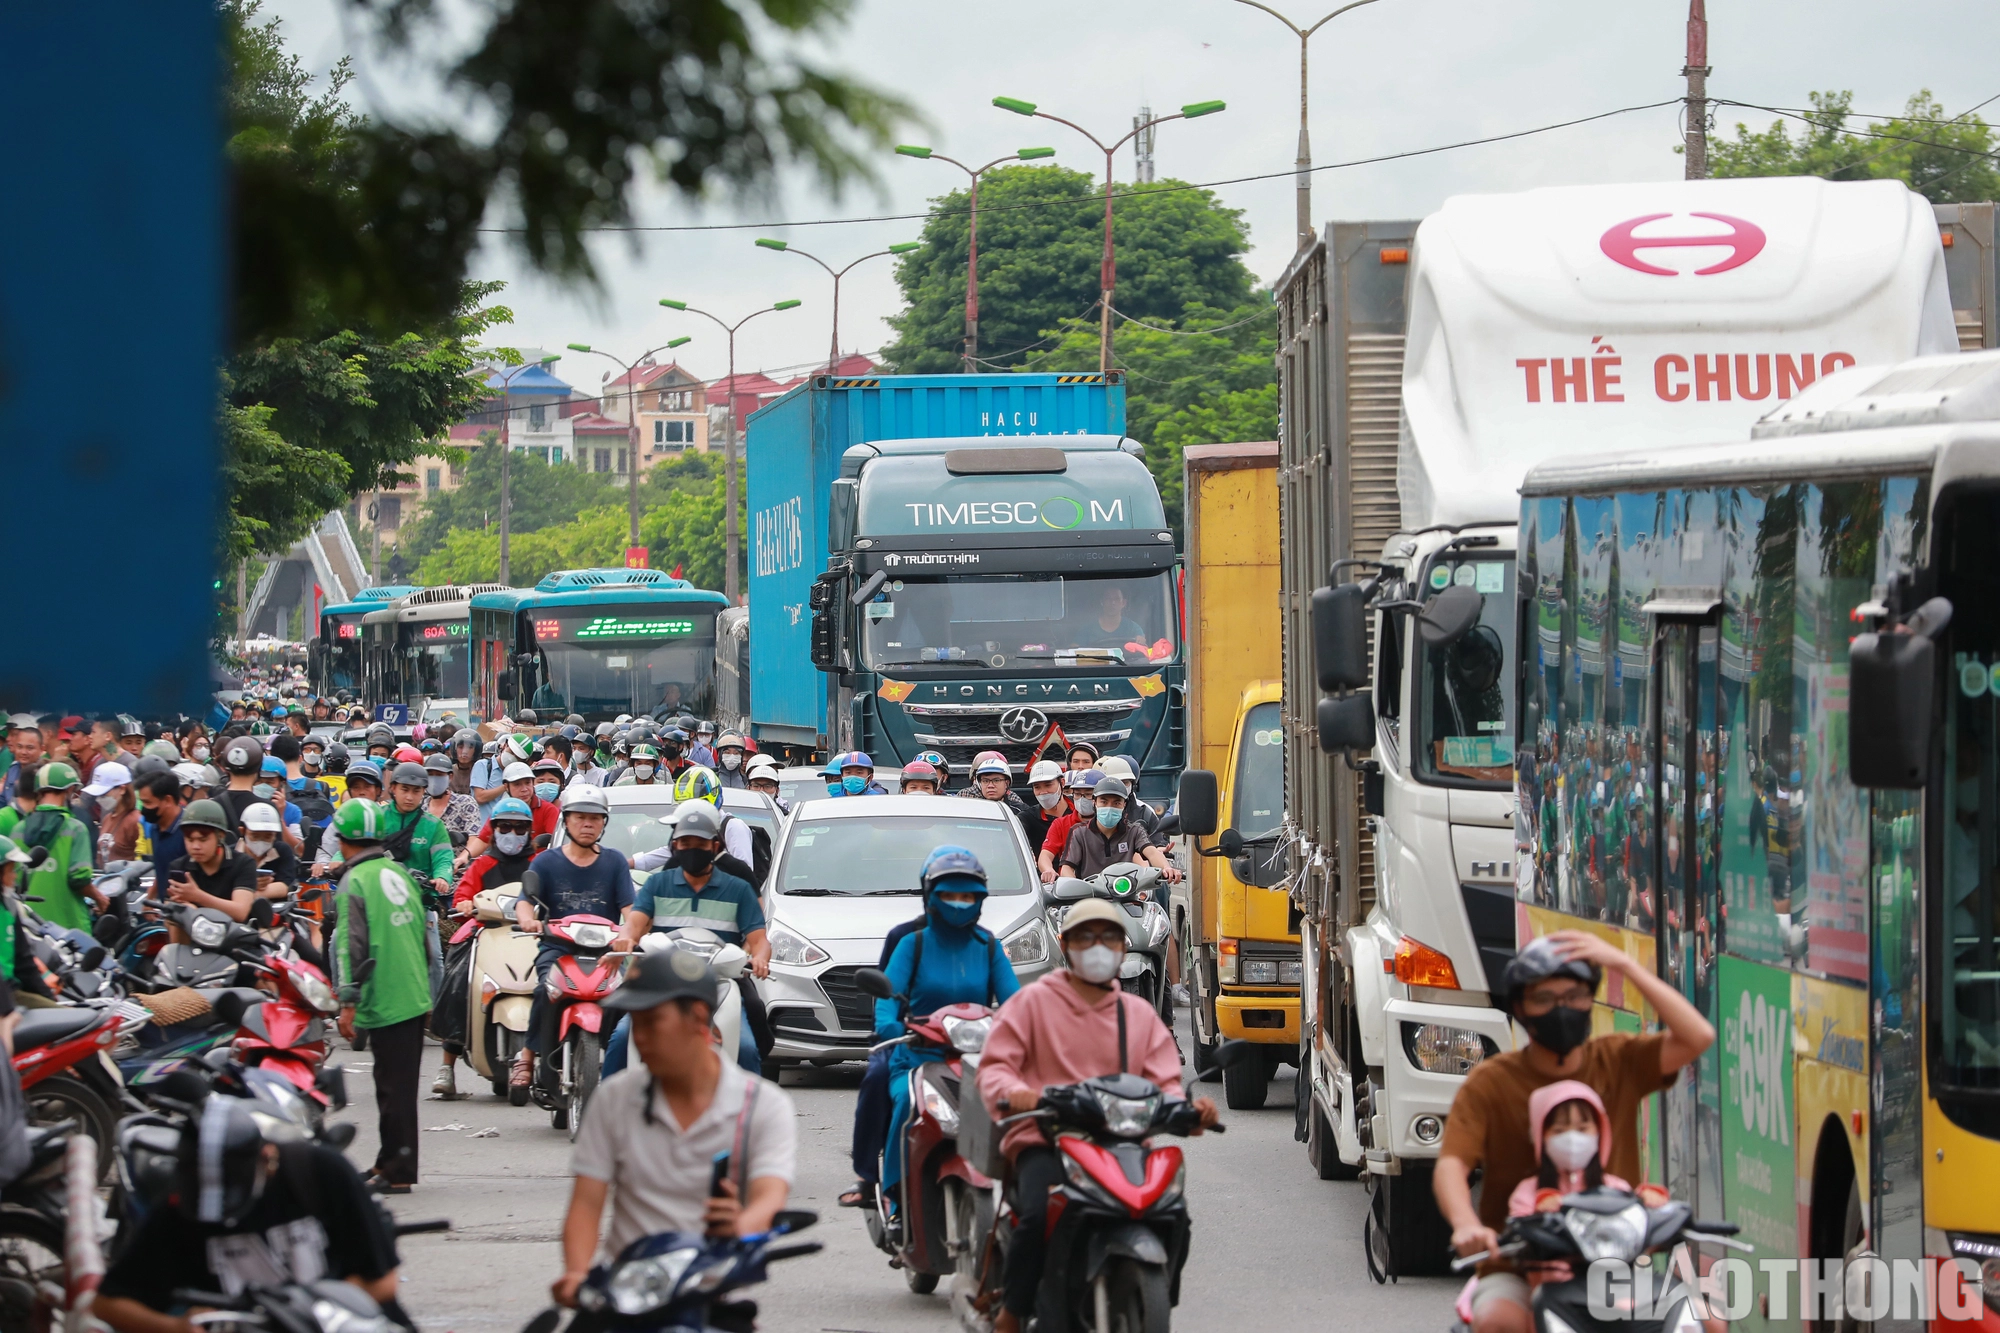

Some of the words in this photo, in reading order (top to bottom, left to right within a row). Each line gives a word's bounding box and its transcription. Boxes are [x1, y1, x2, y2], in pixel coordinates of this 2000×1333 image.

[1516, 336, 1625, 403] THẾ
[981, 411, 1038, 427] HACU
[905, 496, 1125, 531] TIMESCOM
[424, 624, 446, 639] 60A
[933, 683, 1110, 697] HONGYAN
[1738, 988, 1790, 1148] 69K
